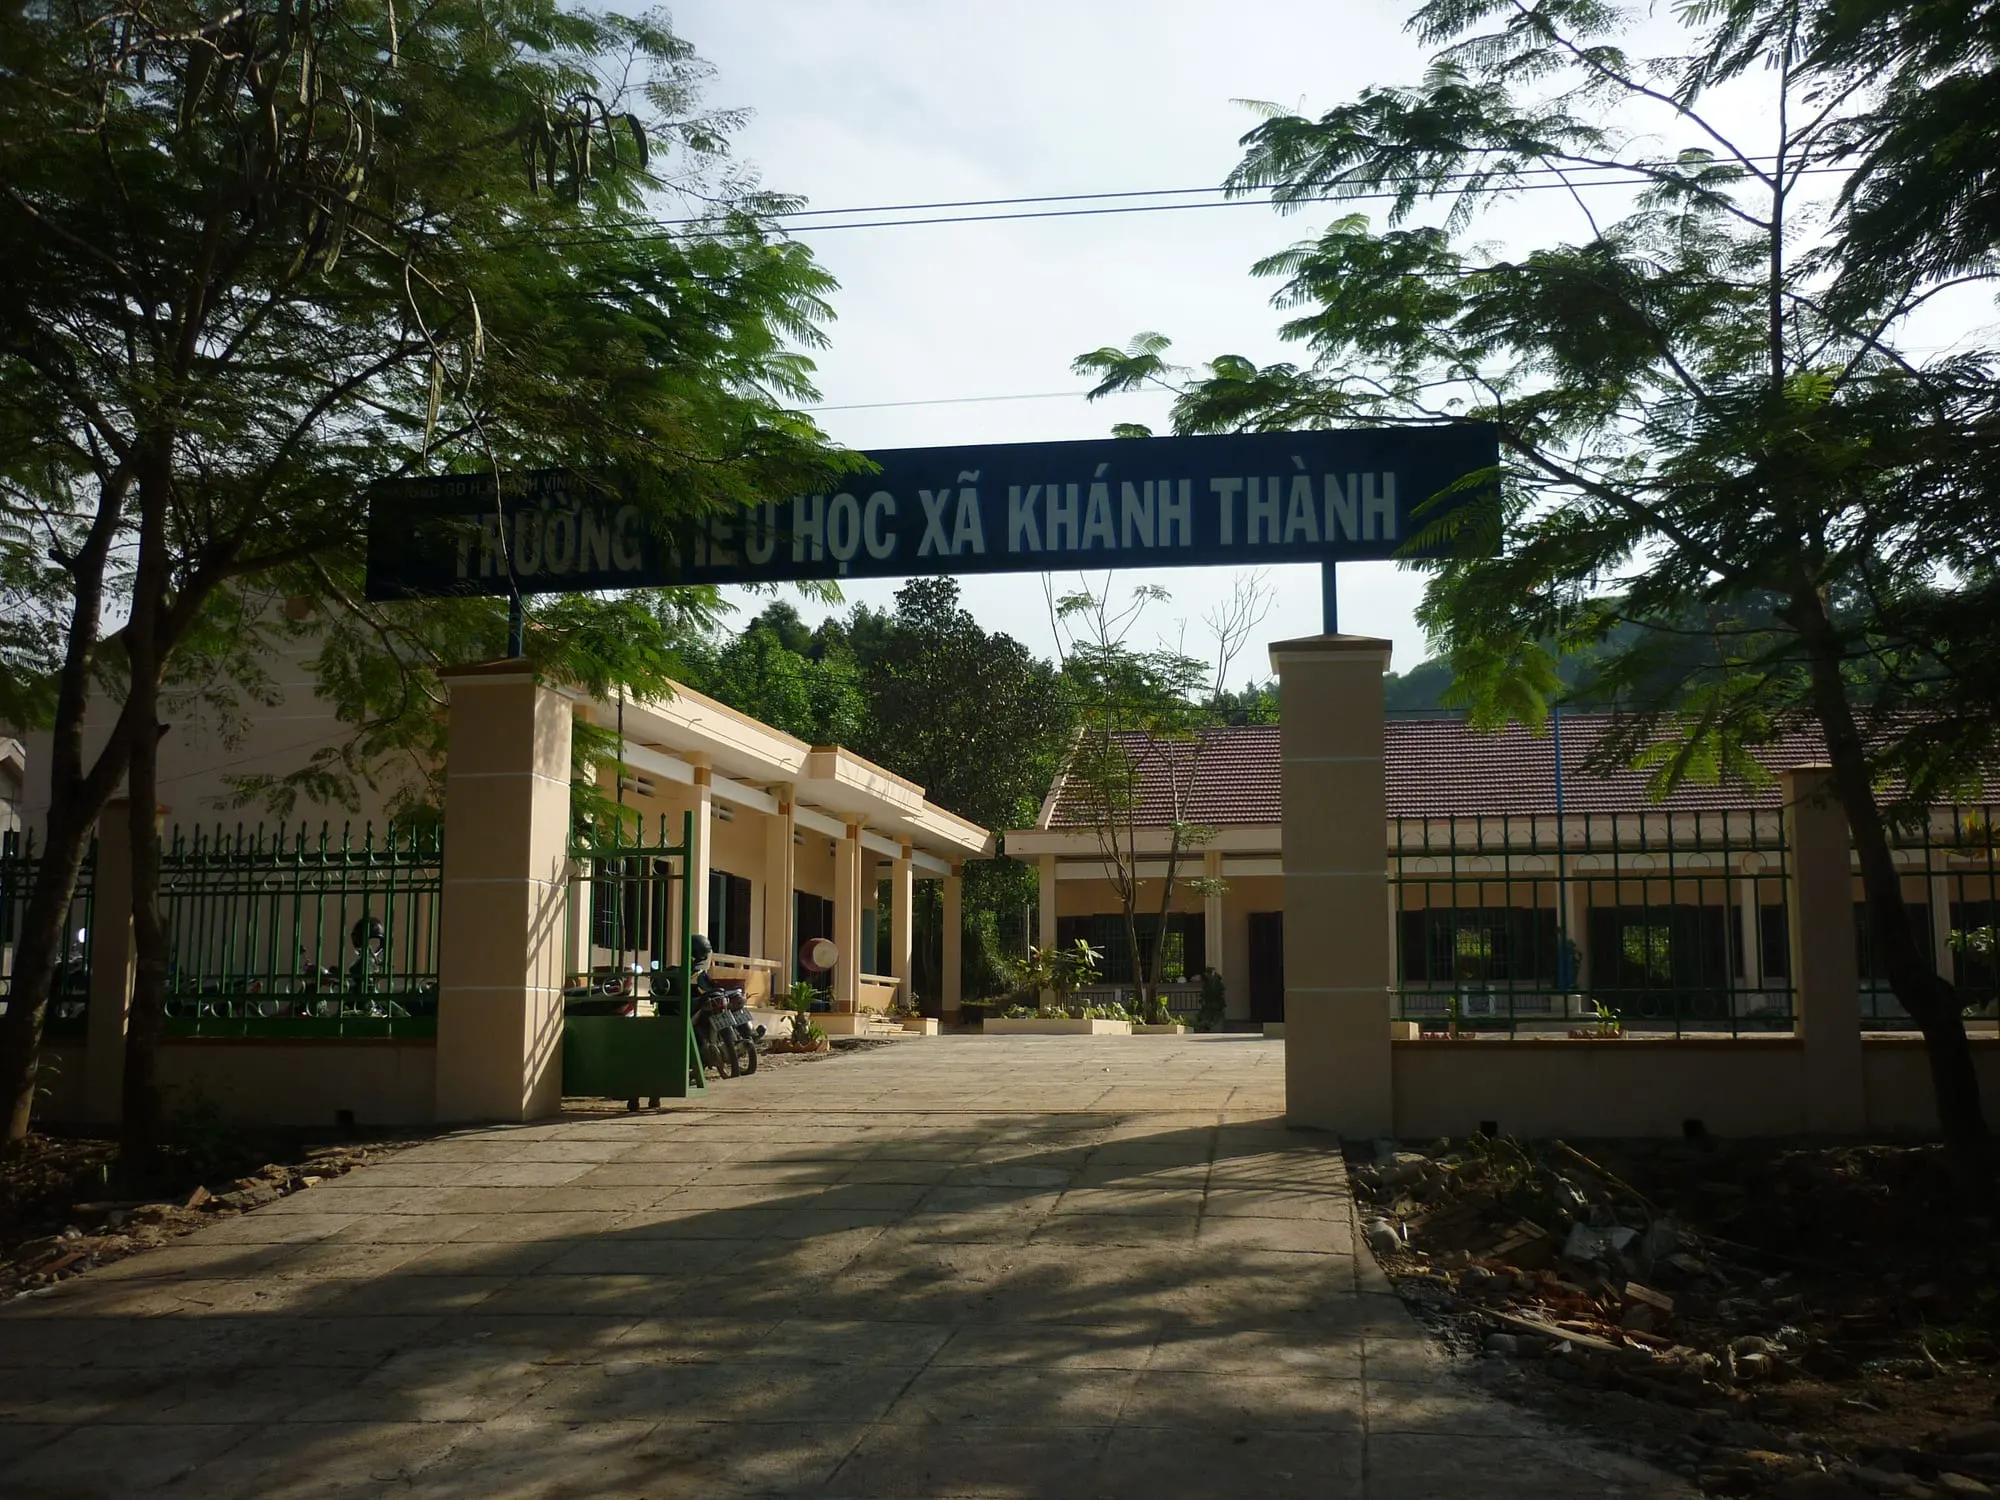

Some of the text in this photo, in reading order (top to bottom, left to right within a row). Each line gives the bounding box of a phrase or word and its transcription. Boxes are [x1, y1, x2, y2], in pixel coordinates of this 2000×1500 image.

[791, 490, 897, 576] HỌC
[917, 470, 986, 557] XÃ
[1007, 462, 1192, 553] KHÁNH
[1209, 455, 1397, 545] THÀNH
